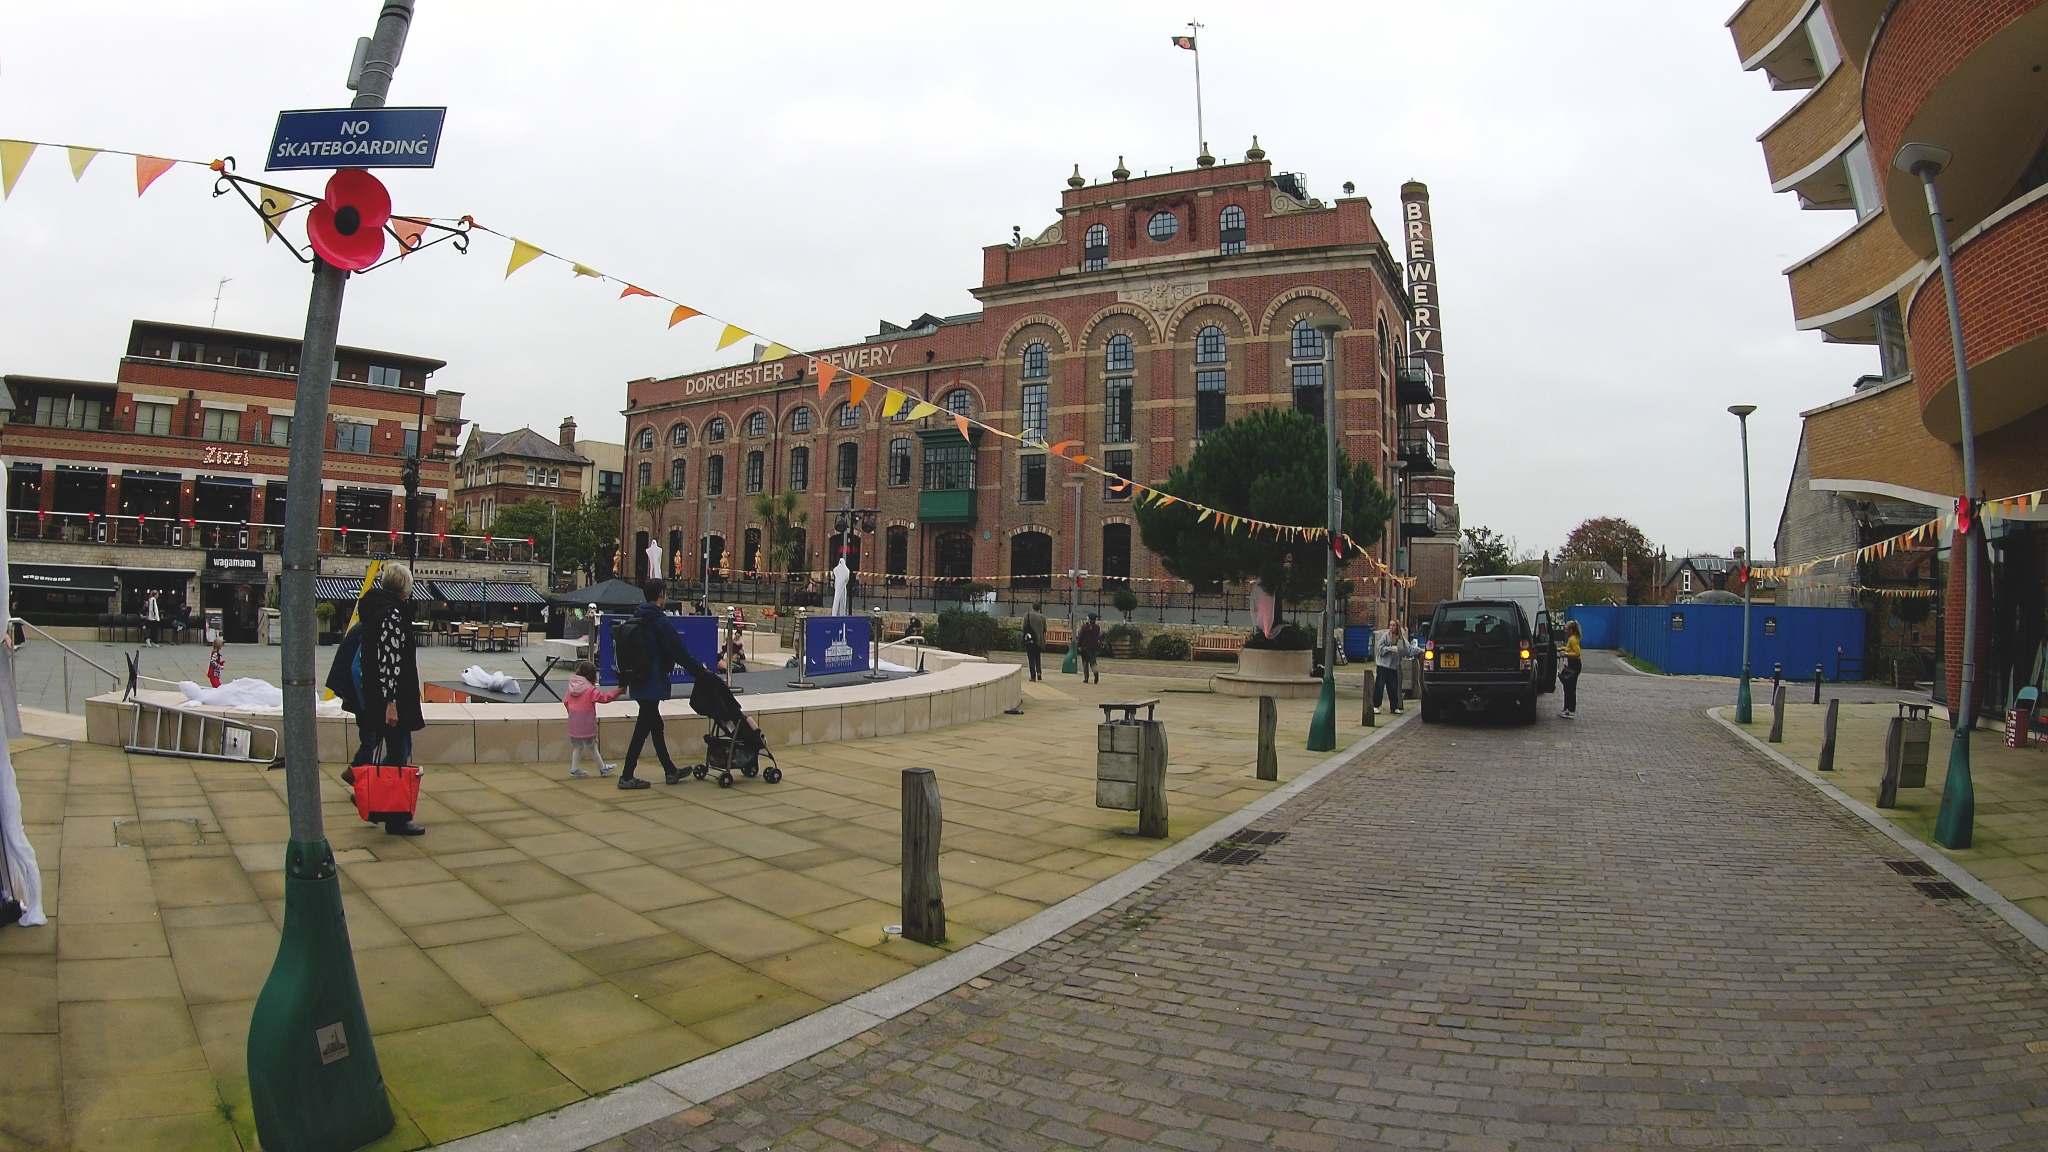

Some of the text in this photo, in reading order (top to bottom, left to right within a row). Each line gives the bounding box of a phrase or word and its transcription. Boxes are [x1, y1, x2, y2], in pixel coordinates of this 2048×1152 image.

[340, 120, 370, 136] NO
[276, 139, 429, 158] SKATEBOARDING
[1406, 202, 1432, 349] BREWERY
[685, 362, 785, 396] DORCHESTER
[203, 446, 249, 466] Zizzi
[213, 558, 256, 569] wagamama
